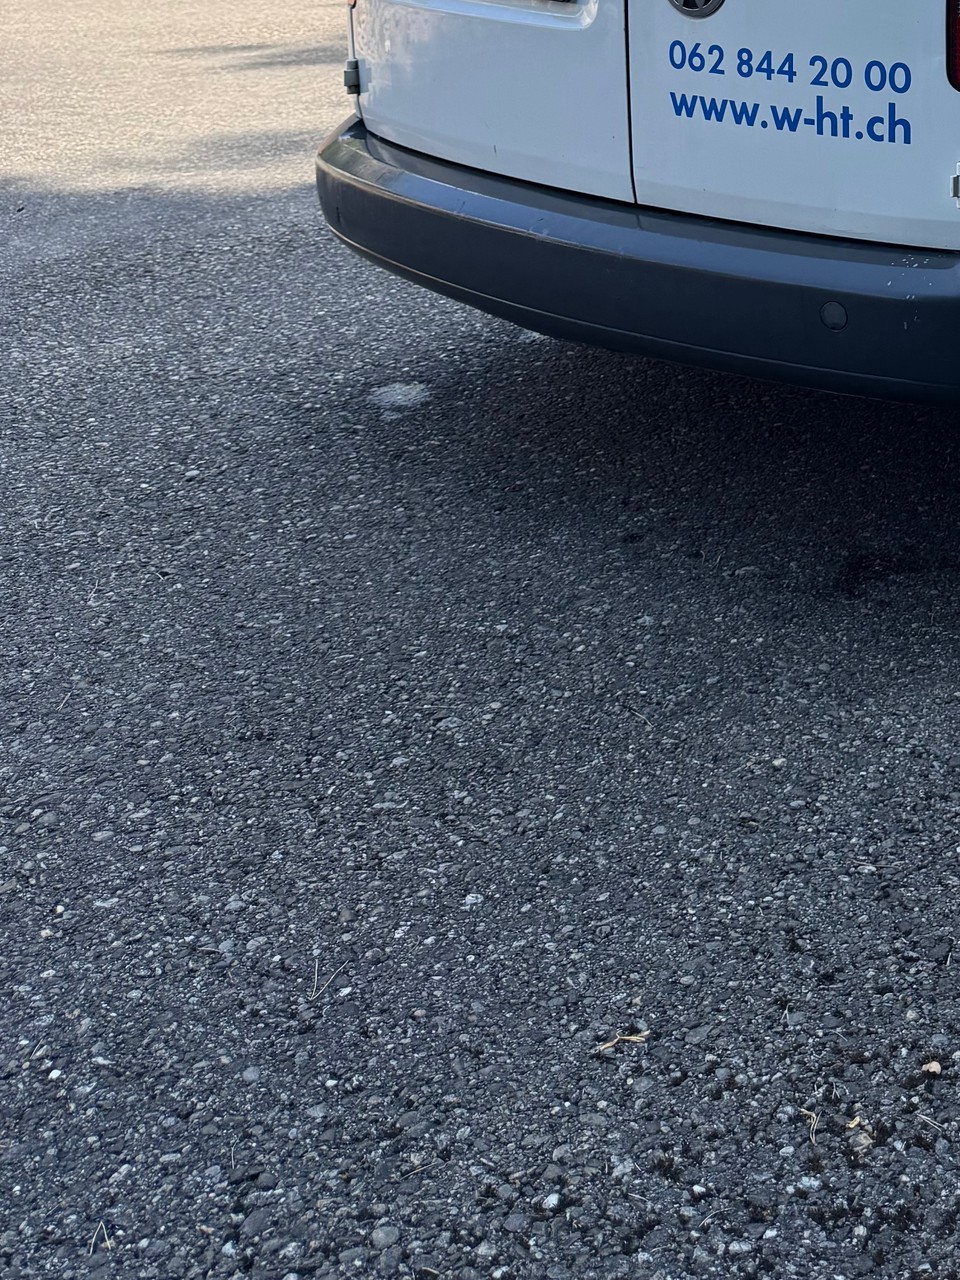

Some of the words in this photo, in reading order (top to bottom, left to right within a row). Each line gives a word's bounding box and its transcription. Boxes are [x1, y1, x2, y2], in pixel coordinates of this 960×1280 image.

[669, 40, 725, 75] 062
[736, 48, 797, 83] 844
[809, 55, 852, 89] 20
[864, 60, 912, 94] 00
[669, 91, 912, 145] www.w-ht.ch
